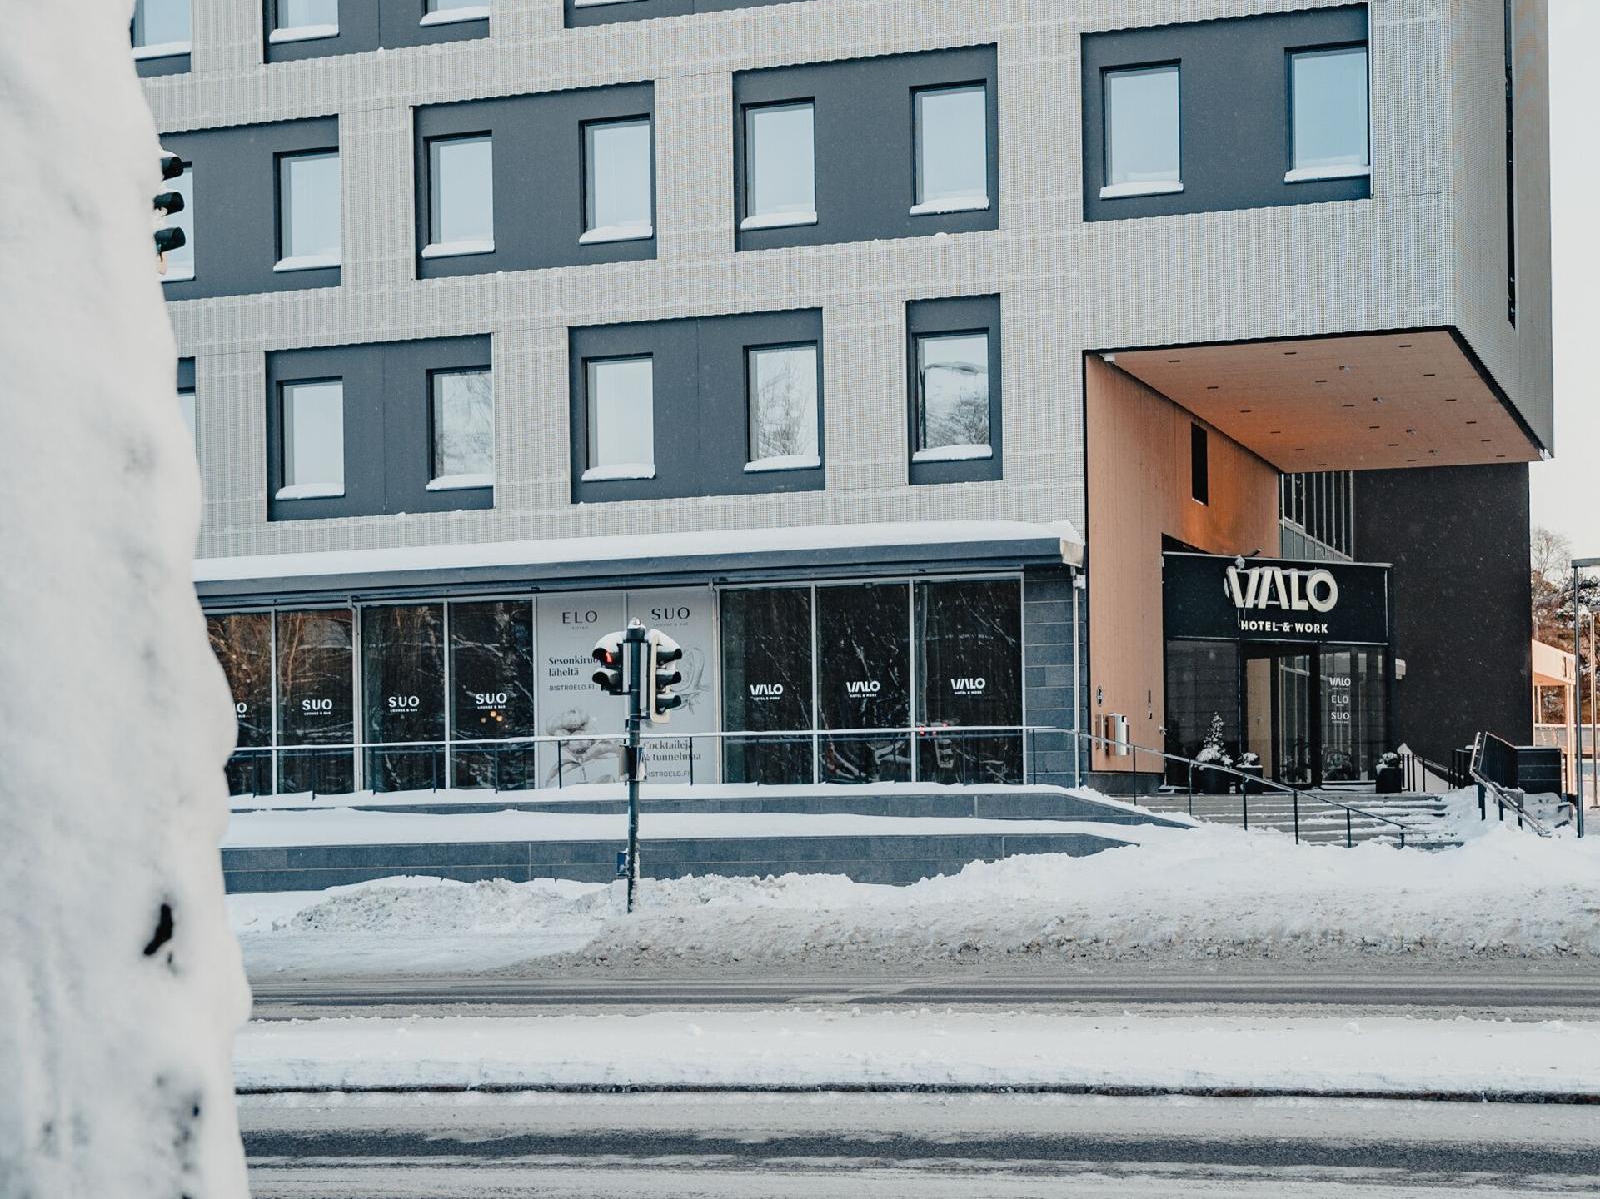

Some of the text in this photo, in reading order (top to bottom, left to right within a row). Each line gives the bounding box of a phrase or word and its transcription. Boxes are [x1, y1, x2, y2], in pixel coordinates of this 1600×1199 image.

[1226, 566, 1339, 612] VALO
[562, 610, 598, 624] ELO
[651, 606, 690, 620] SUO
[1240, 620, 1329, 634] HOTEL & WORK
[845, 680, 880, 693] VALO
[950, 677, 986, 690] VALO
[1329, 677, 1351, 687] VALO
[749, 683, 784, 695] VALO
[302, 698, 332, 710] SUO
[388, 695, 420, 707] SUO
[475, 692, 507, 704] SUO
[1331, 694, 1349, 704] ELO
[1331, 711, 1350, 720] SUO
